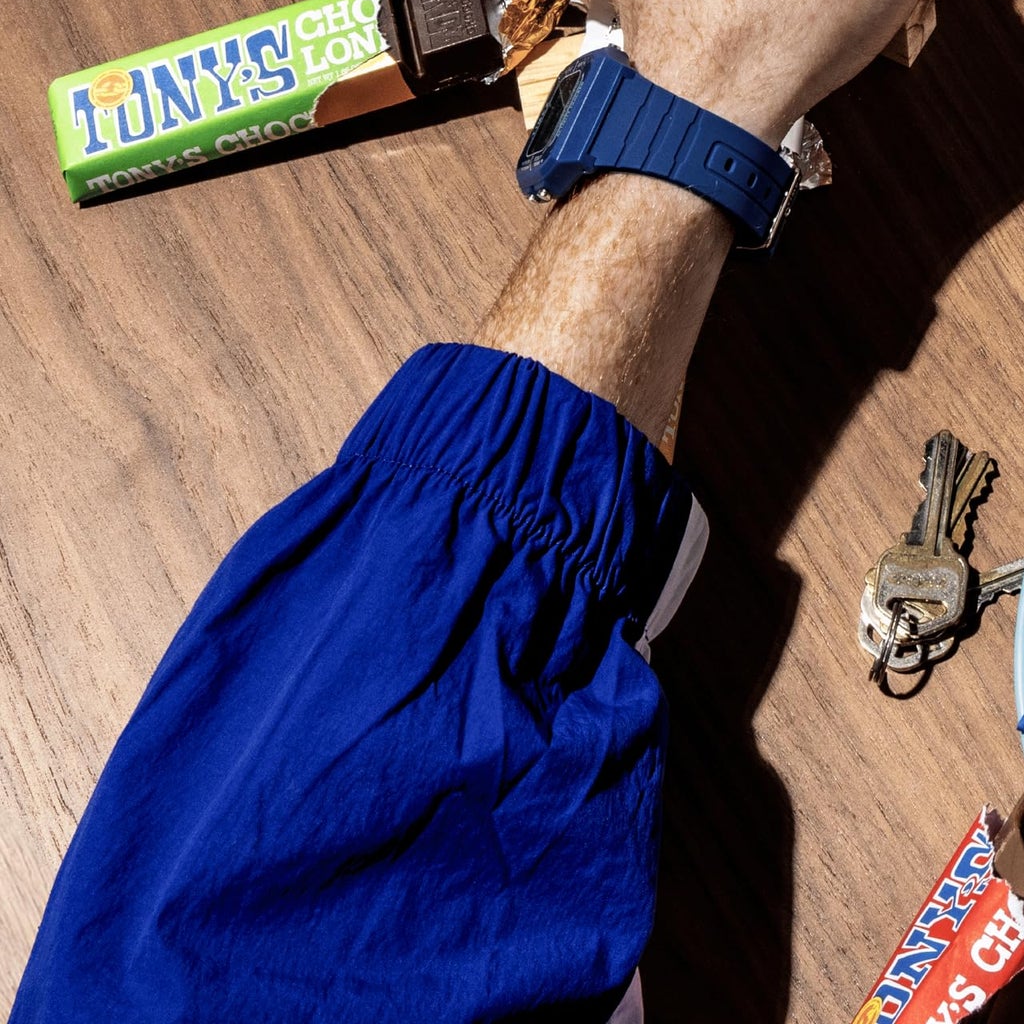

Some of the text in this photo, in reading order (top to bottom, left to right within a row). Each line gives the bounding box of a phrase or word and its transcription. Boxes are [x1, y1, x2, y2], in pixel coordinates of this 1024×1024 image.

[69, 19, 300, 157] TONY'S
[86, 112, 314, 194] TONY'S CHOC
